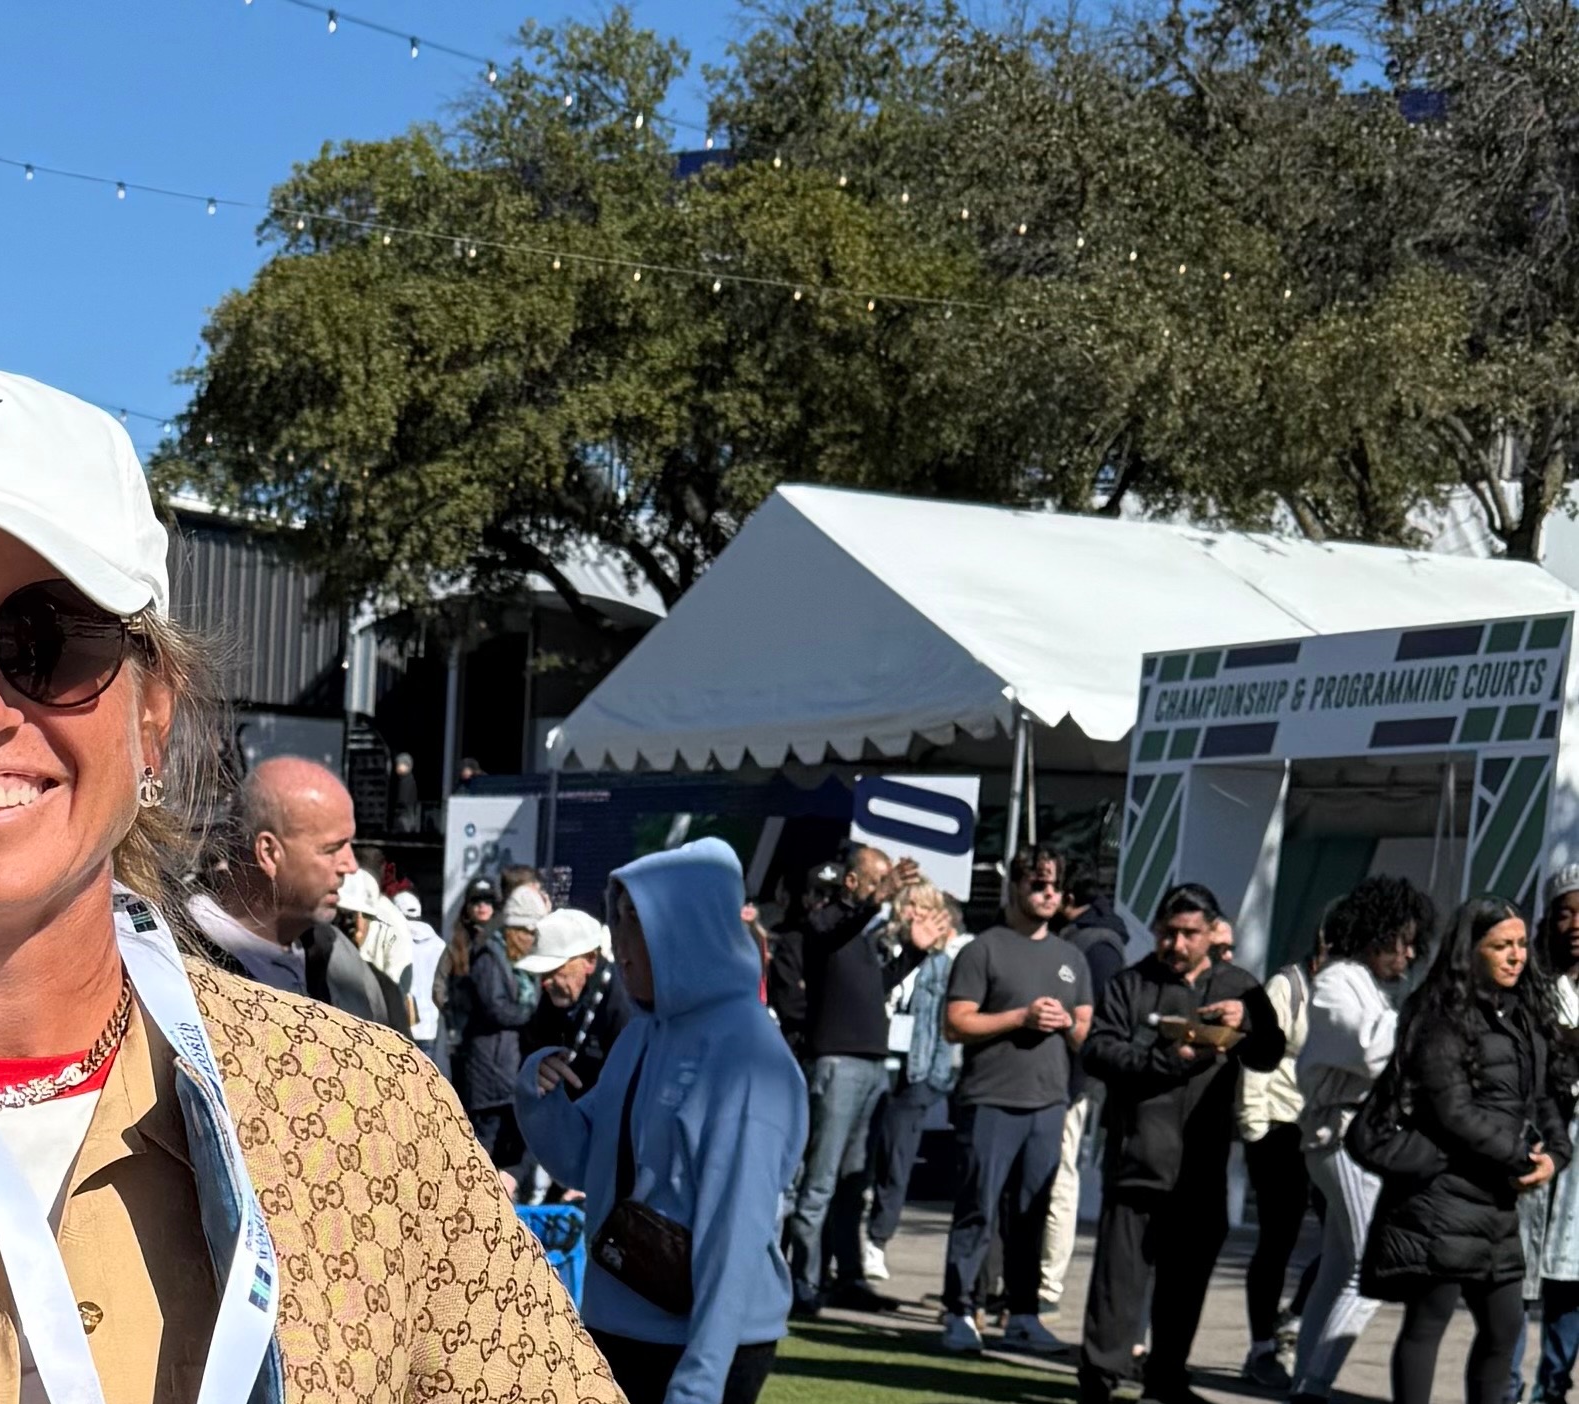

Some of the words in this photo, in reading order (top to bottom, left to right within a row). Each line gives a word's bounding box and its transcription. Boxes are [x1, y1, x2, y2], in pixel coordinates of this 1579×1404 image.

[1154, 679, 1289, 722] CHAMPIONSHIP
[1290, 677, 1307, 712] &
[1309, 665, 1460, 711] PROGRAMMING
[1463, 657, 1548, 700] COURTS
